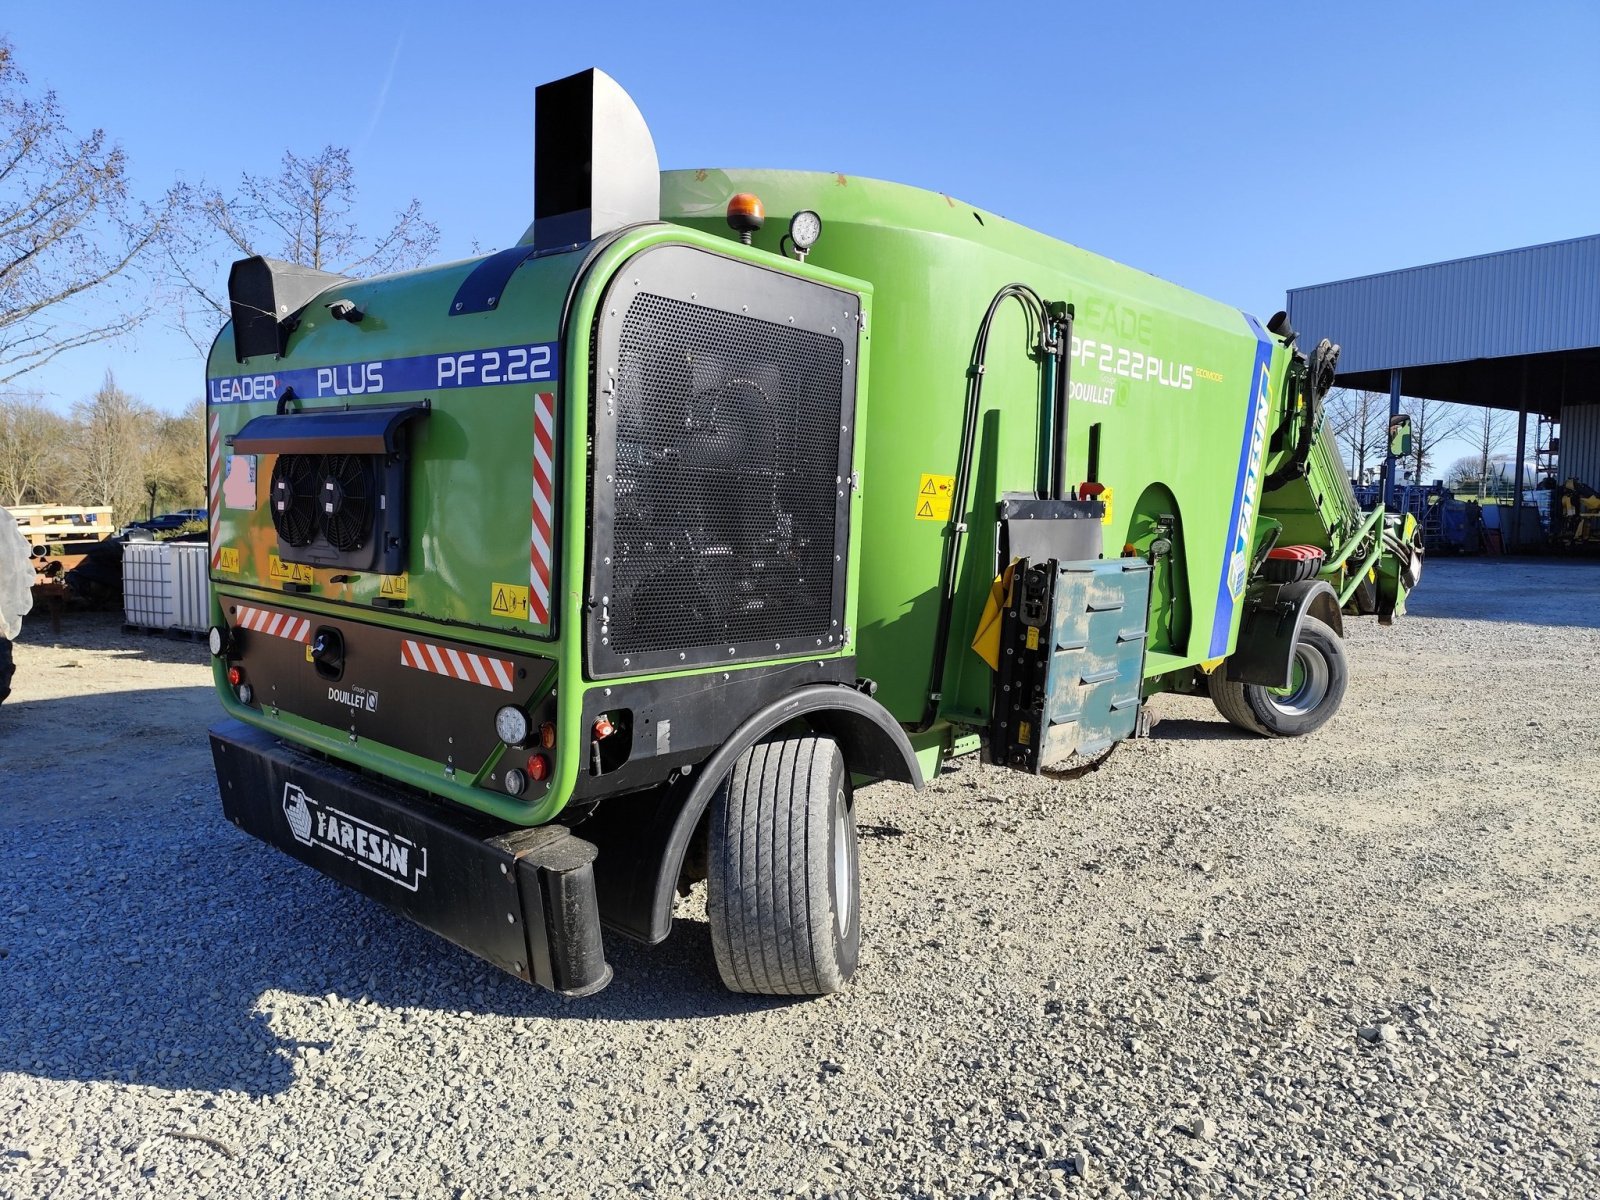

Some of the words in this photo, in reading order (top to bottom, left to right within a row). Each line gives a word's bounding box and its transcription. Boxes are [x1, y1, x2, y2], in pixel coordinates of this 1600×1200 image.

[317, 362, 384, 397] PLUS
[437, 354, 476, 387] PF
[481, 346, 551, 383] 2.22
[1098, 344, 1144, 380] 2.22
[1146, 356, 1194, 390] PLUS
[1239, 391, 1270, 544] FARESIN
[328, 687, 365, 709] DOUILLET
